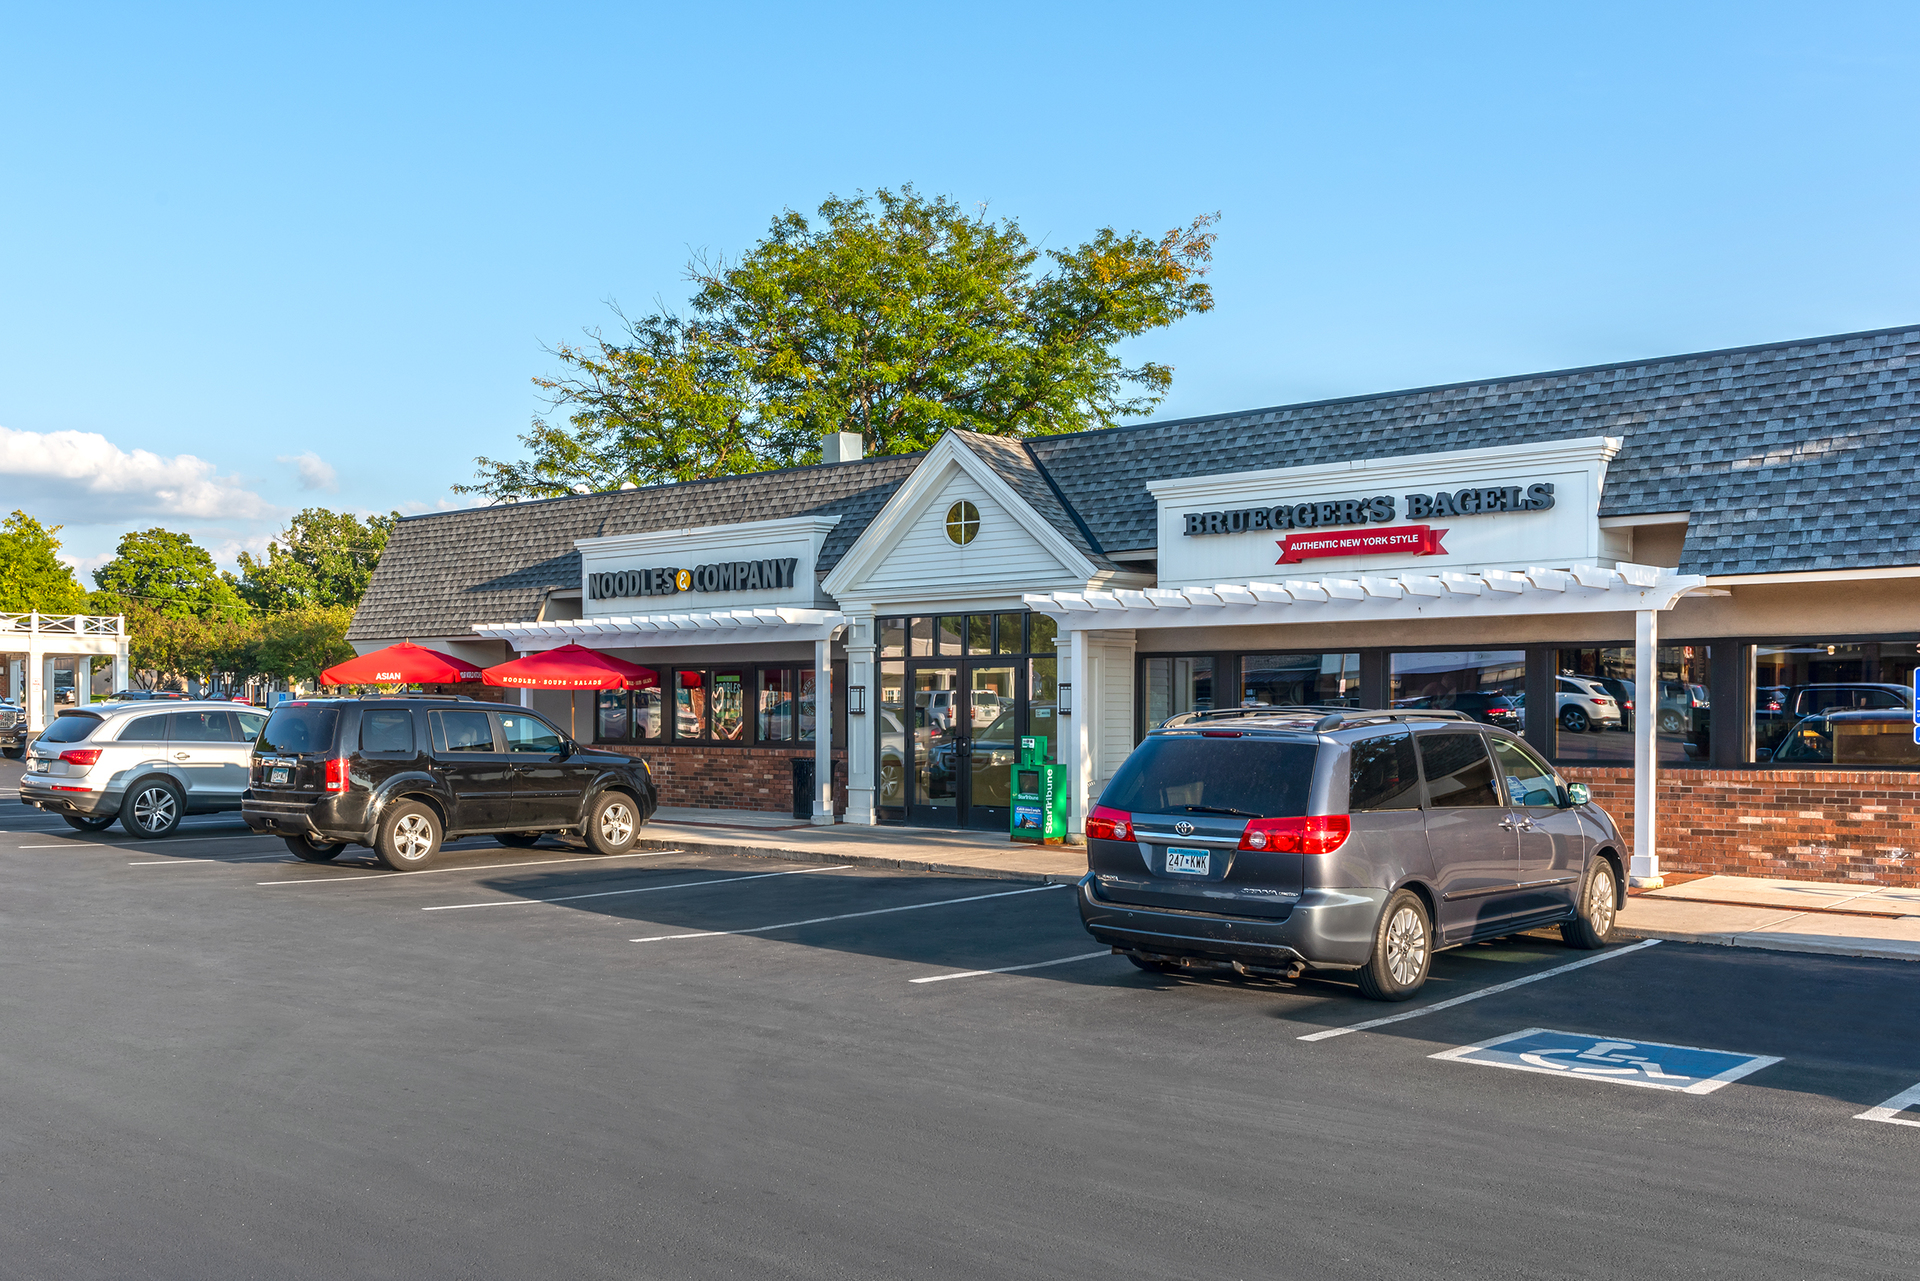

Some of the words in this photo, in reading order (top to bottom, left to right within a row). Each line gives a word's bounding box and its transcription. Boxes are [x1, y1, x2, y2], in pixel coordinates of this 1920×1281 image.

[1183, 495, 1395, 536] BRUEGGER'S
[1405, 482, 1555, 520] BAGELS
[1290, 539, 1339, 551] AUTHENTIC
[1340, 538, 1361, 548] NEW
[1362, 536, 1388, 546] YORK
[1389, 534, 1419, 544] STYLE
[588, 567, 680, 600] NOODLES
[678, 570, 689, 591] &
[693, 558, 799, 593] COMPANY
[375, 672, 401, 680] ASIAN
[502, 677, 536, 685] NOODLES
[1045, 769, 1053, 834] StarTribune
[1169, 853, 1185, 867] 247
[1190, 855, 1207, 869] KWK
